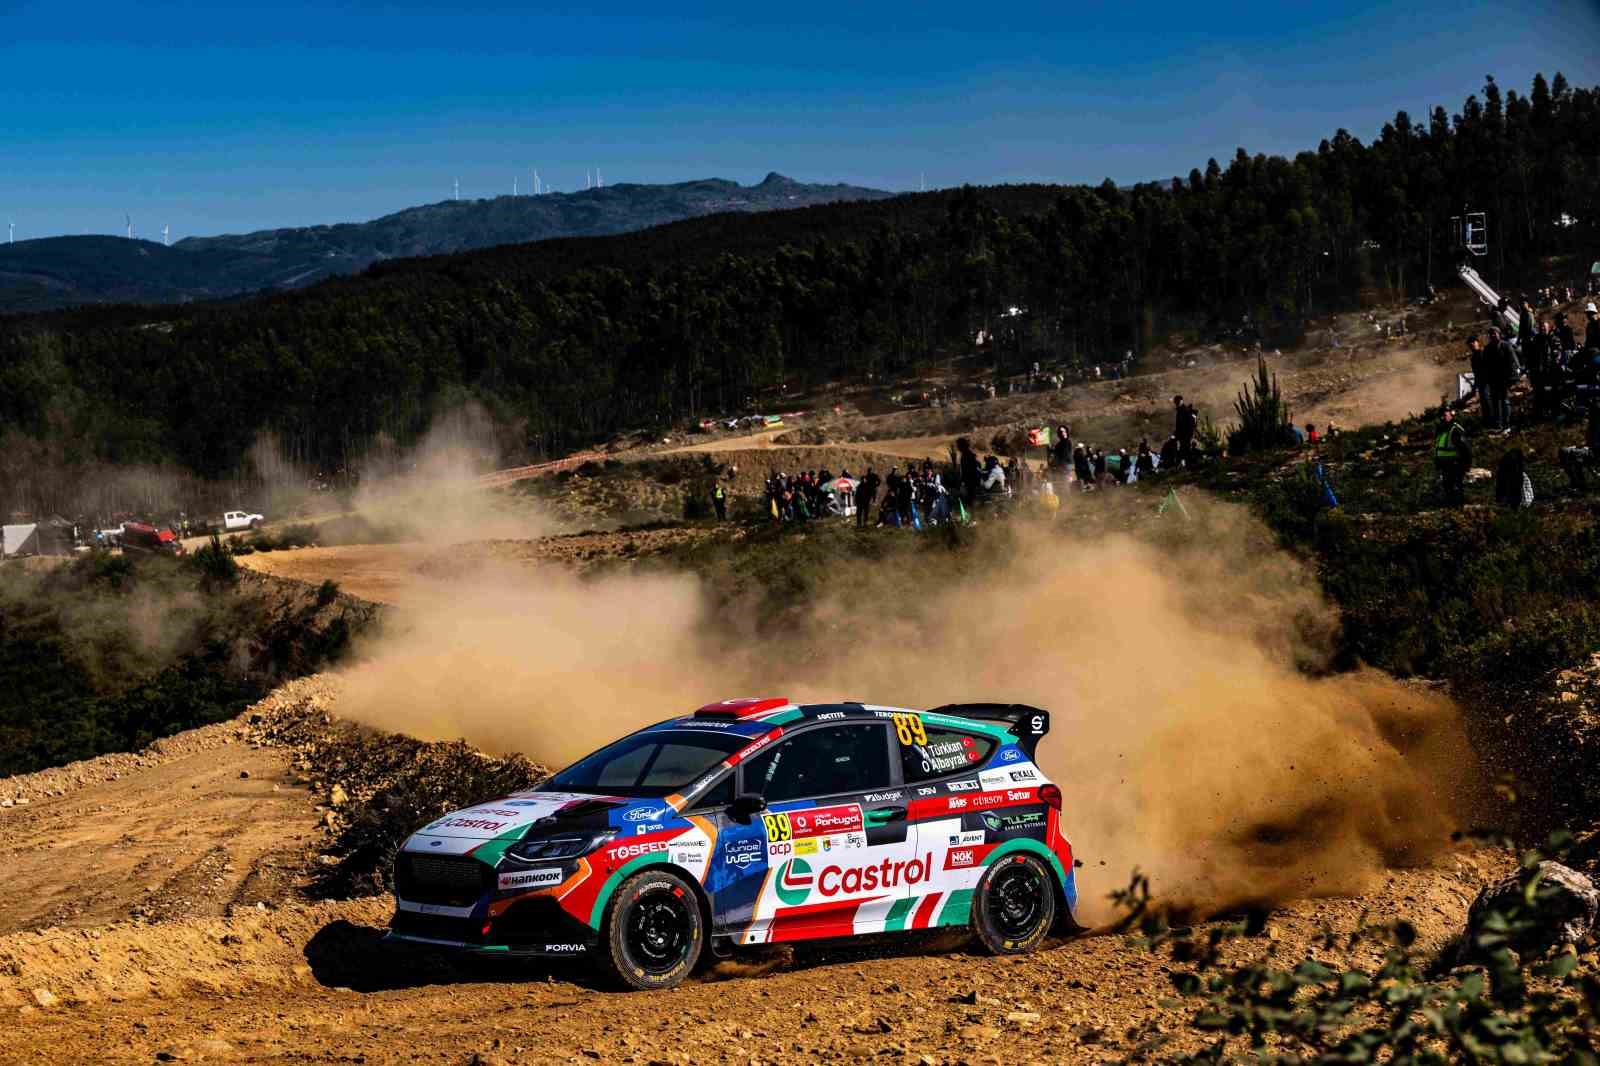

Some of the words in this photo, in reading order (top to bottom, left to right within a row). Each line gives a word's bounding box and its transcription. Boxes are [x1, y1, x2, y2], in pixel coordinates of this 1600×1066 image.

[816, 711, 847, 720] LOCTITE
[892, 712, 928, 746] 89
[927, 742, 963, 757] Türkkan
[921, 760, 931, 773] O
[931, 754, 968, 771] Albayrak
[873, 790, 903, 801] Budget
[917, 786, 938, 796] DSV
[1007, 790, 1031, 801] Setur
[446, 818, 508, 830] Castrol
[815, 814, 860, 827] Portugal
[765, 814, 791, 842] 89
[607, 840, 670, 861] TOSFED
[769, 843, 792, 856] ocp
[952, 851, 974, 861] NGK
[725, 851, 762, 865] WRC
[817, 851, 933, 897] Castrol
[545, 943, 587, 952] FORVIA
